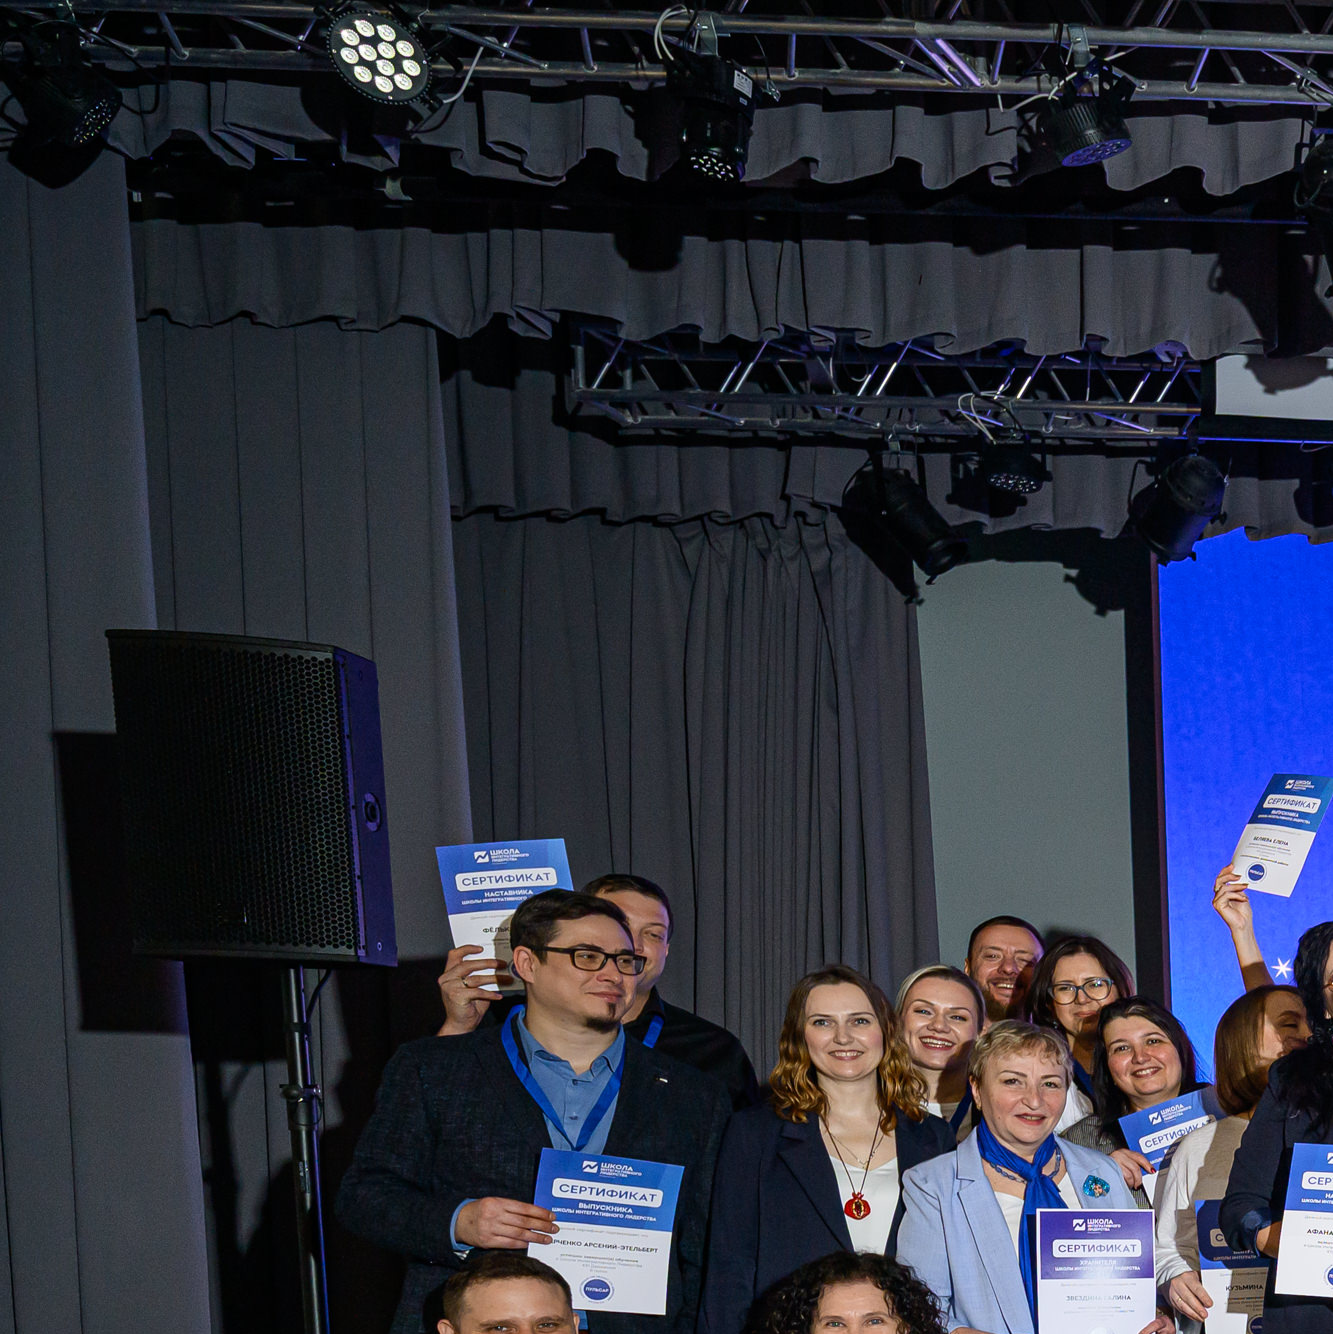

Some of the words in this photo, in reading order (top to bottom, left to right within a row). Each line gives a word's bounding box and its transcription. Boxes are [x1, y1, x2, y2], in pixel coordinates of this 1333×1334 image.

[1267, 797, 1317, 810] СЕРТИФИКАТ
[462, 872, 551, 887] СЕРТИФИКАТ
[485, 889, 533, 898] НАСТАВНИКА
[559, 1183, 657, 1203] СЕРТИФИКАТ
[578, 1202, 633, 1214] ВЫПУСКНИКА
[1058, 1244, 1137, 1253] СЕРТИФИКАТ
